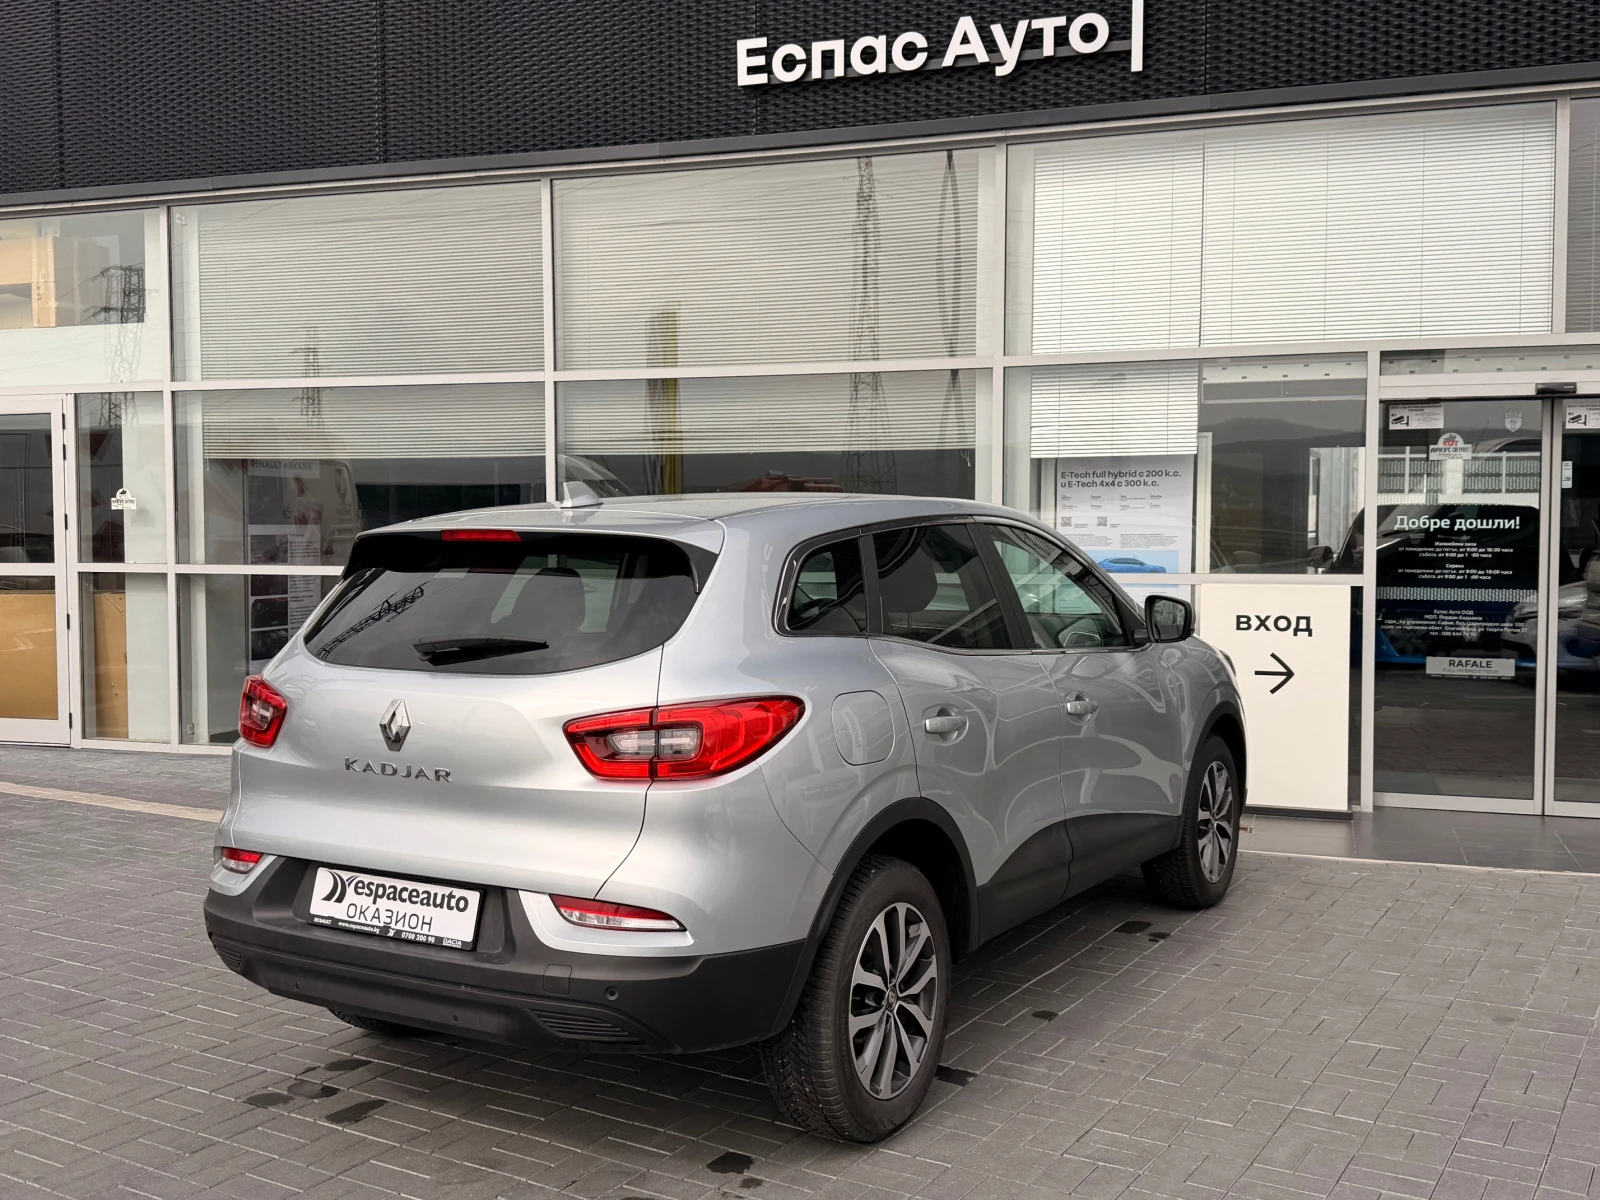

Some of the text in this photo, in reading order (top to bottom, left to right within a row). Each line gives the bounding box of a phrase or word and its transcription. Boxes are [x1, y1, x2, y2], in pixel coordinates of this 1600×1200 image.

[736, 12, 1110, 86] Еспас Ауто
[250, 460, 312, 470] RENAULT ARKANA
[1061, 471, 1091, 479] E-Tech
[1092, 470, 1106, 478] full
[1108, 470, 1137, 479] hybrid
[1394, 515, 1520, 531] Добре дошли!
[1449, 660, 1492, 668] RAFALE
[344, 757, 454, 783] KADJAR
[354, 880, 469, 912] espaceauto
[314, 917, 332, 925] RENAULT
[401, 932, 416, 941] 0700
[417, 934, 426, 942] 200
[346, 903, 433, 932] ОКАЗИОН
